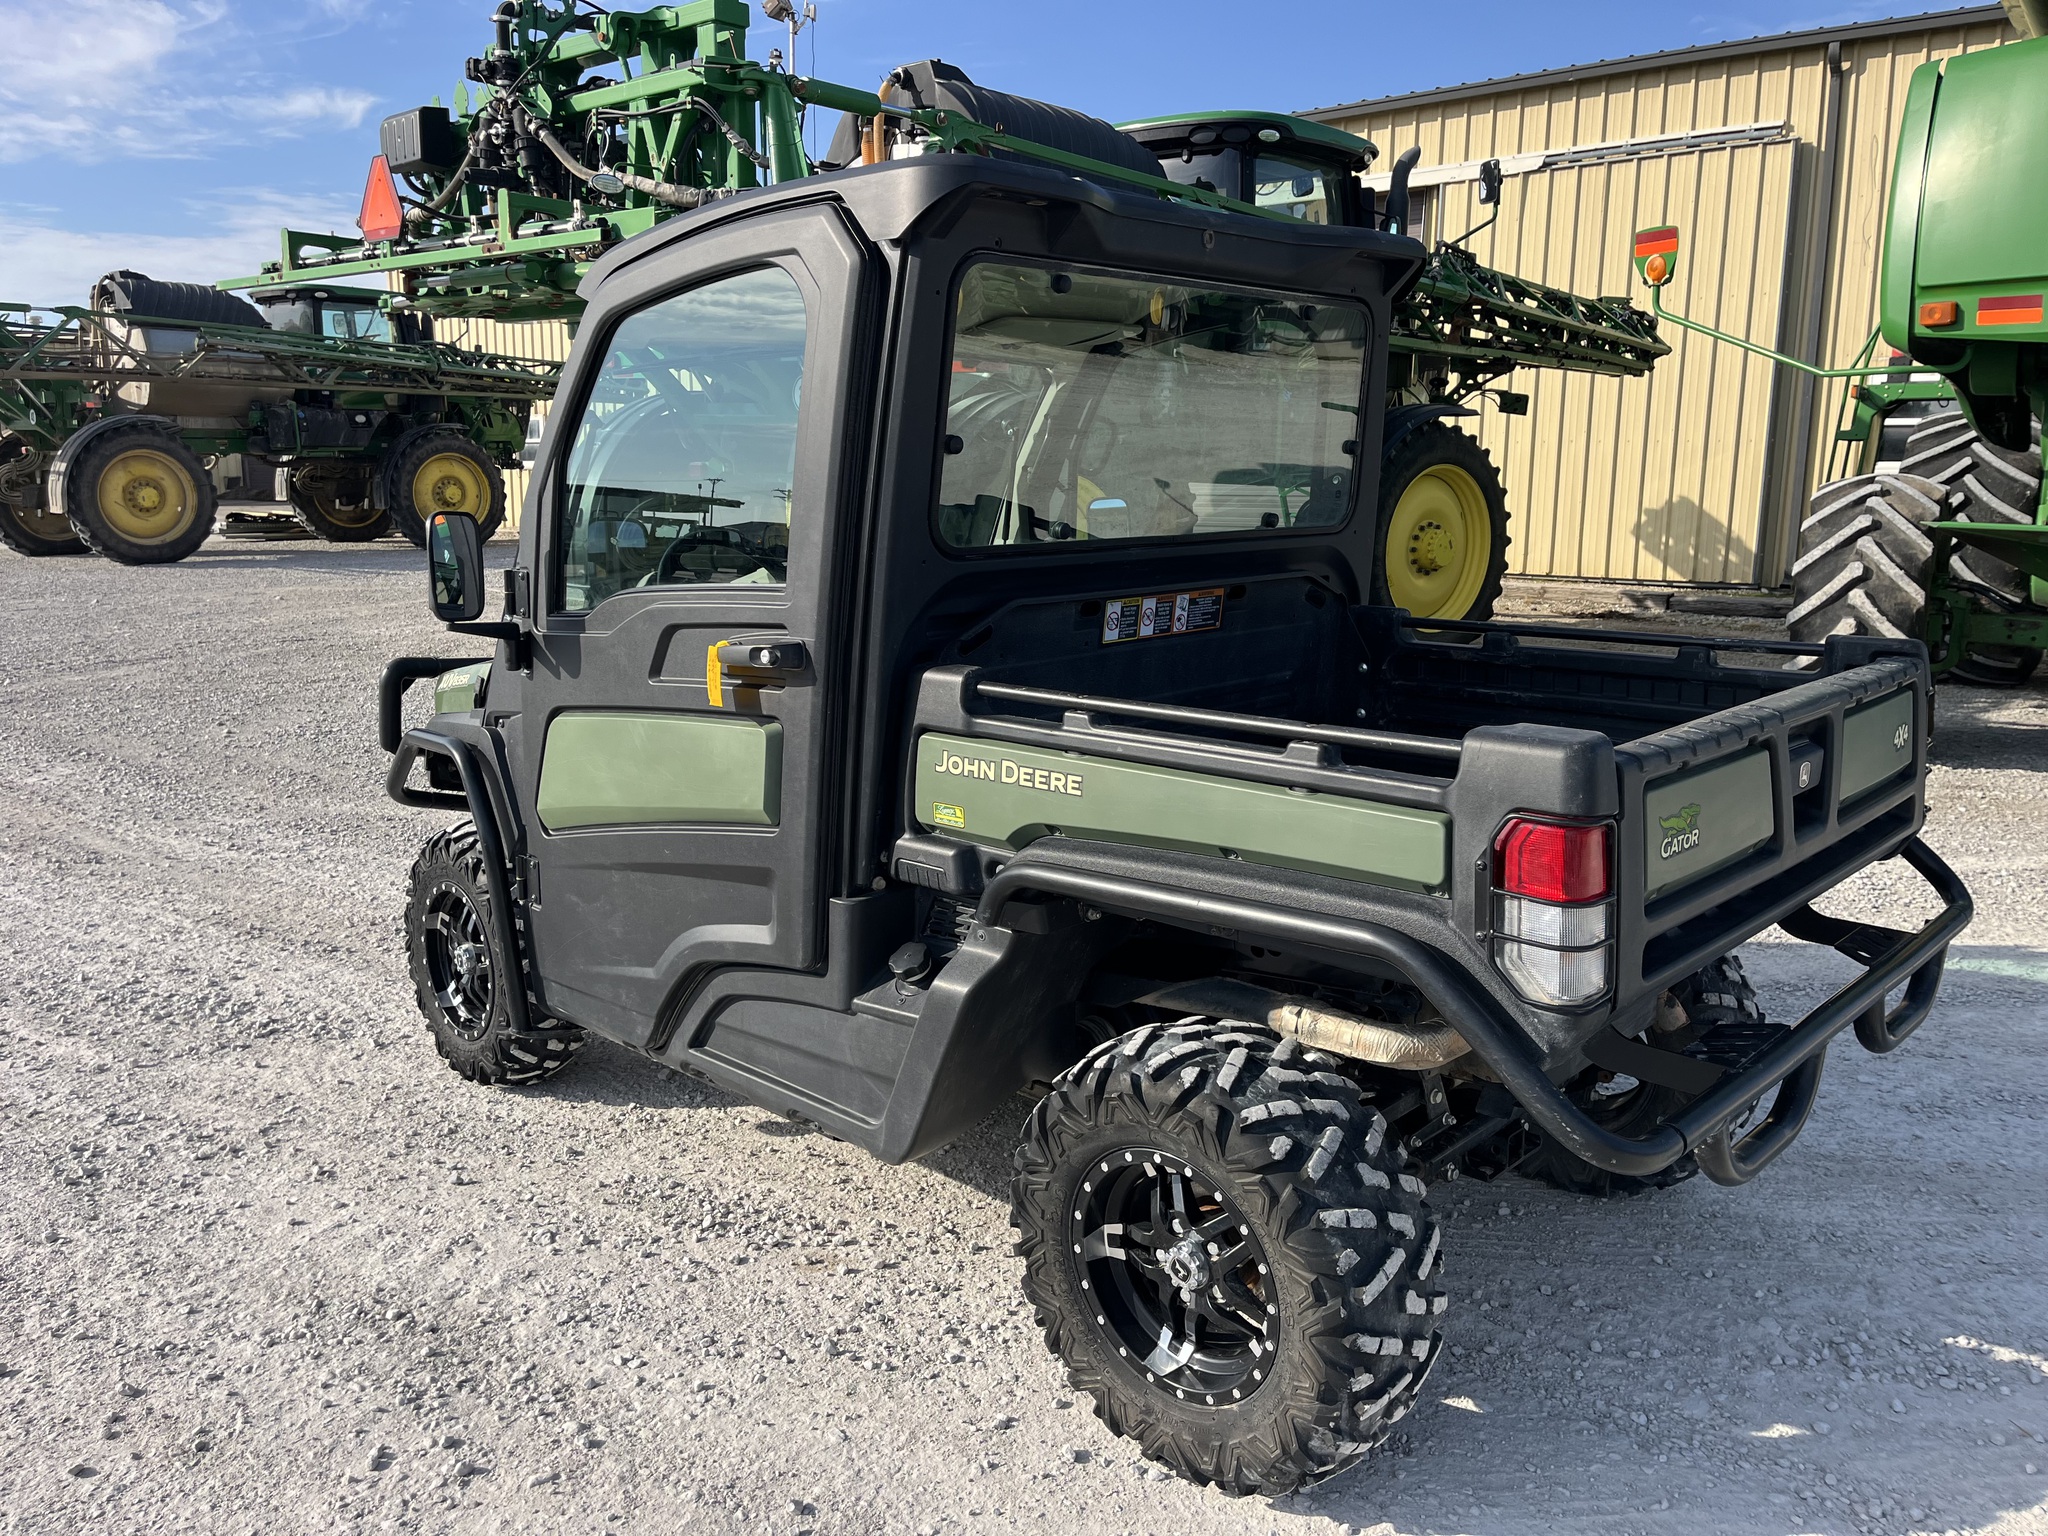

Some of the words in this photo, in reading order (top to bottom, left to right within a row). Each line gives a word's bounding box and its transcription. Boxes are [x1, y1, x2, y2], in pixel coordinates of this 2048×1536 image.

[935, 750, 996, 781] JOHN
[1000, 759, 1083, 797] DEERE
[1660, 828, 1700, 859] GATOR
